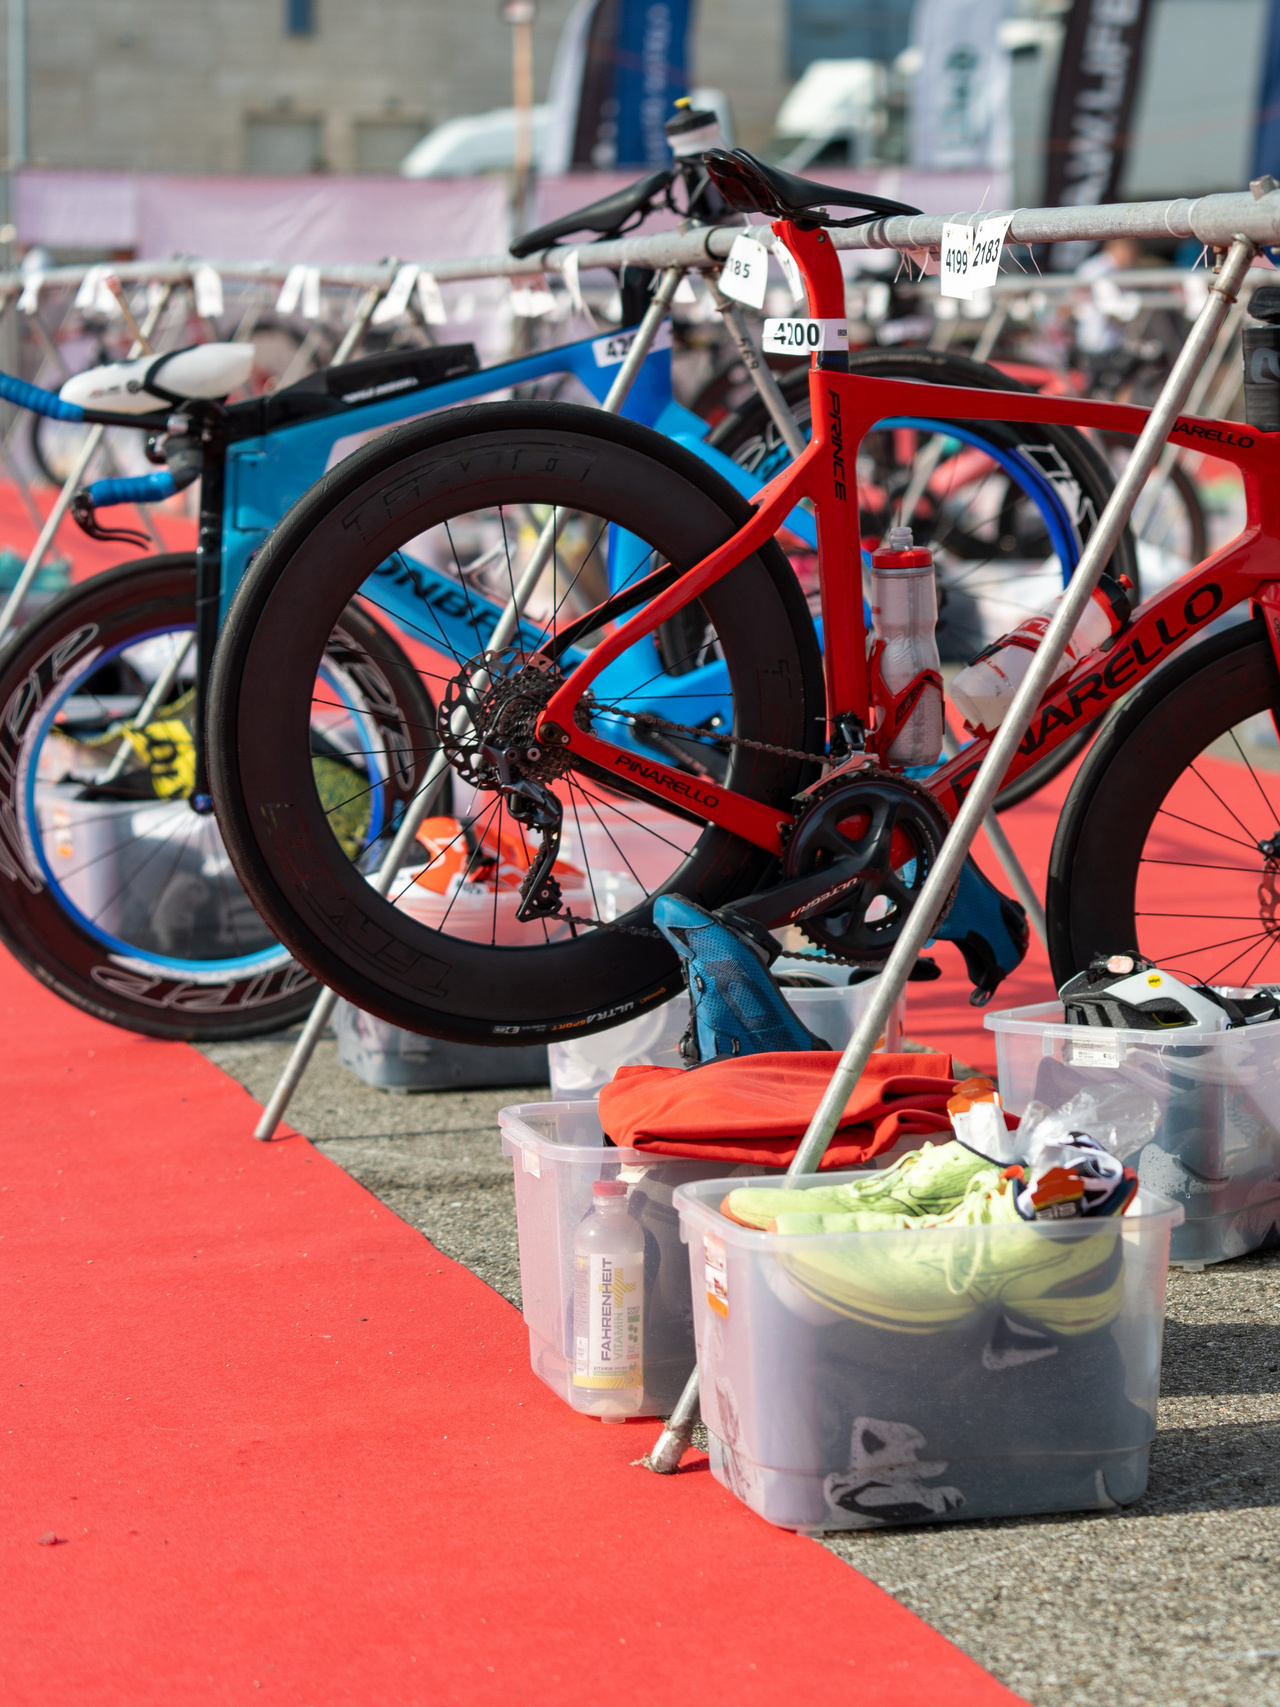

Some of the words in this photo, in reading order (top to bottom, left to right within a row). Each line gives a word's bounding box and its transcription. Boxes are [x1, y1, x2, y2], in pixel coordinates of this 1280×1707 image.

[946, 248, 968, 275] 4199
[972, 238, 1000, 267] 2183
[774, 322, 820, 346] 4200
[828, 389, 847, 502] PRINCE
[614, 754, 719, 809] PINARELLO
[790, 877, 859, 919] ULTEGRA
[551, 1018, 586, 1031] SPORT
[586, 1001, 634, 1023] ULTRA
[601, 1258, 612, 1361] FAHRENHEIT
[613, 1312, 624, 1360] VITAMIN
